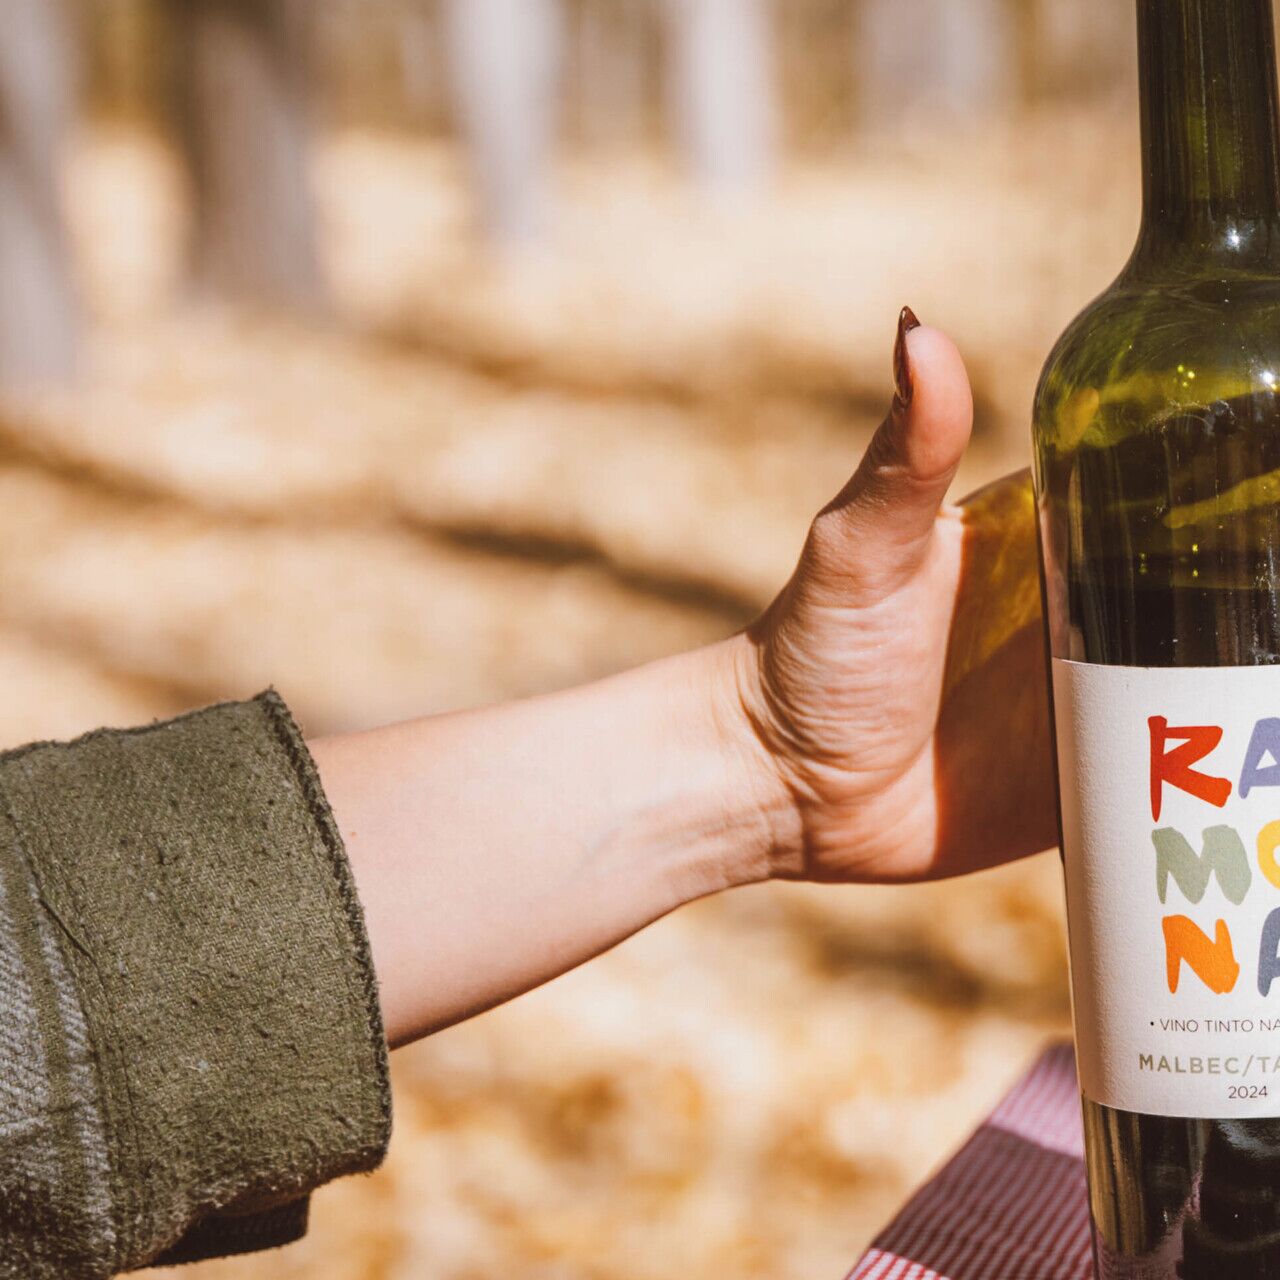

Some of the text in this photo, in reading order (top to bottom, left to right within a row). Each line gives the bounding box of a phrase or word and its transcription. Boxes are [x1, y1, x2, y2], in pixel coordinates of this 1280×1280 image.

[1160, 1019, 1199, 1033] VINO
[1204, 1019, 1255, 1033] TINTO
[1228, 1085, 1268, 1099] 2024
